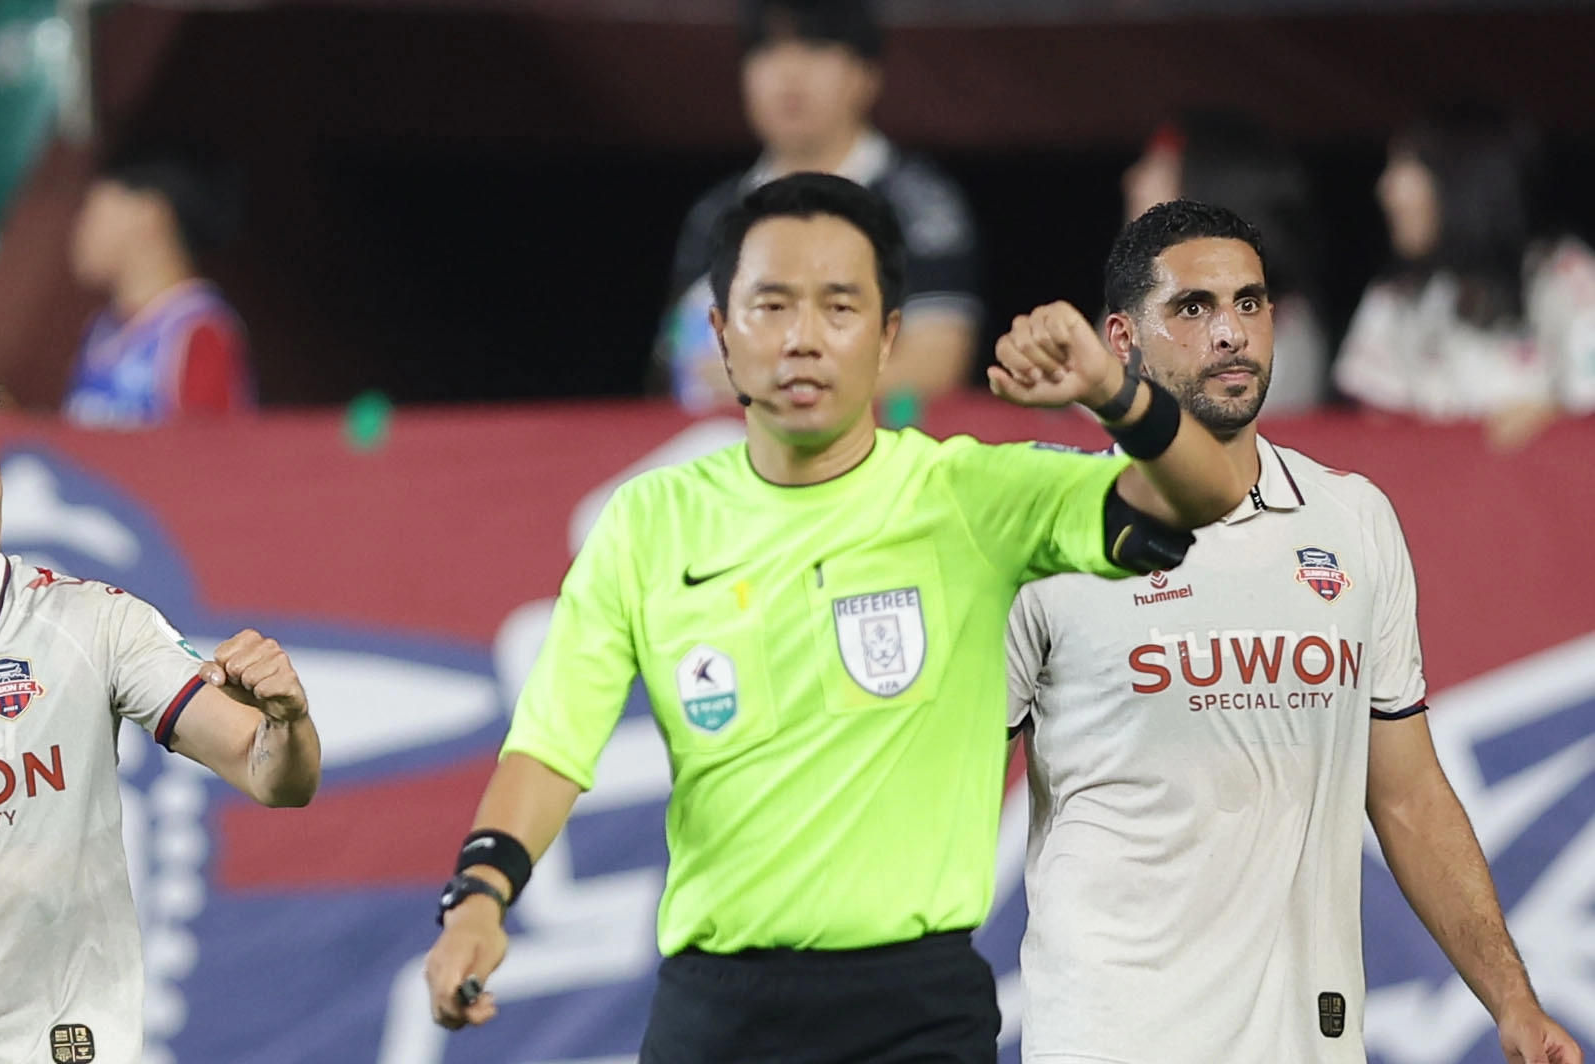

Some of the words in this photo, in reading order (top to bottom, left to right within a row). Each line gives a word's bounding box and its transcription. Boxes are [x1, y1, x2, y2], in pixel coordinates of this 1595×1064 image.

[836, 590, 917, 617] REFEREE
[1133, 584, 1193, 606] hummel
[1128, 635, 1363, 694] SUWON
[1188, 692, 1281, 712] SPECIAL
[1287, 692, 1334, 709] CITY
